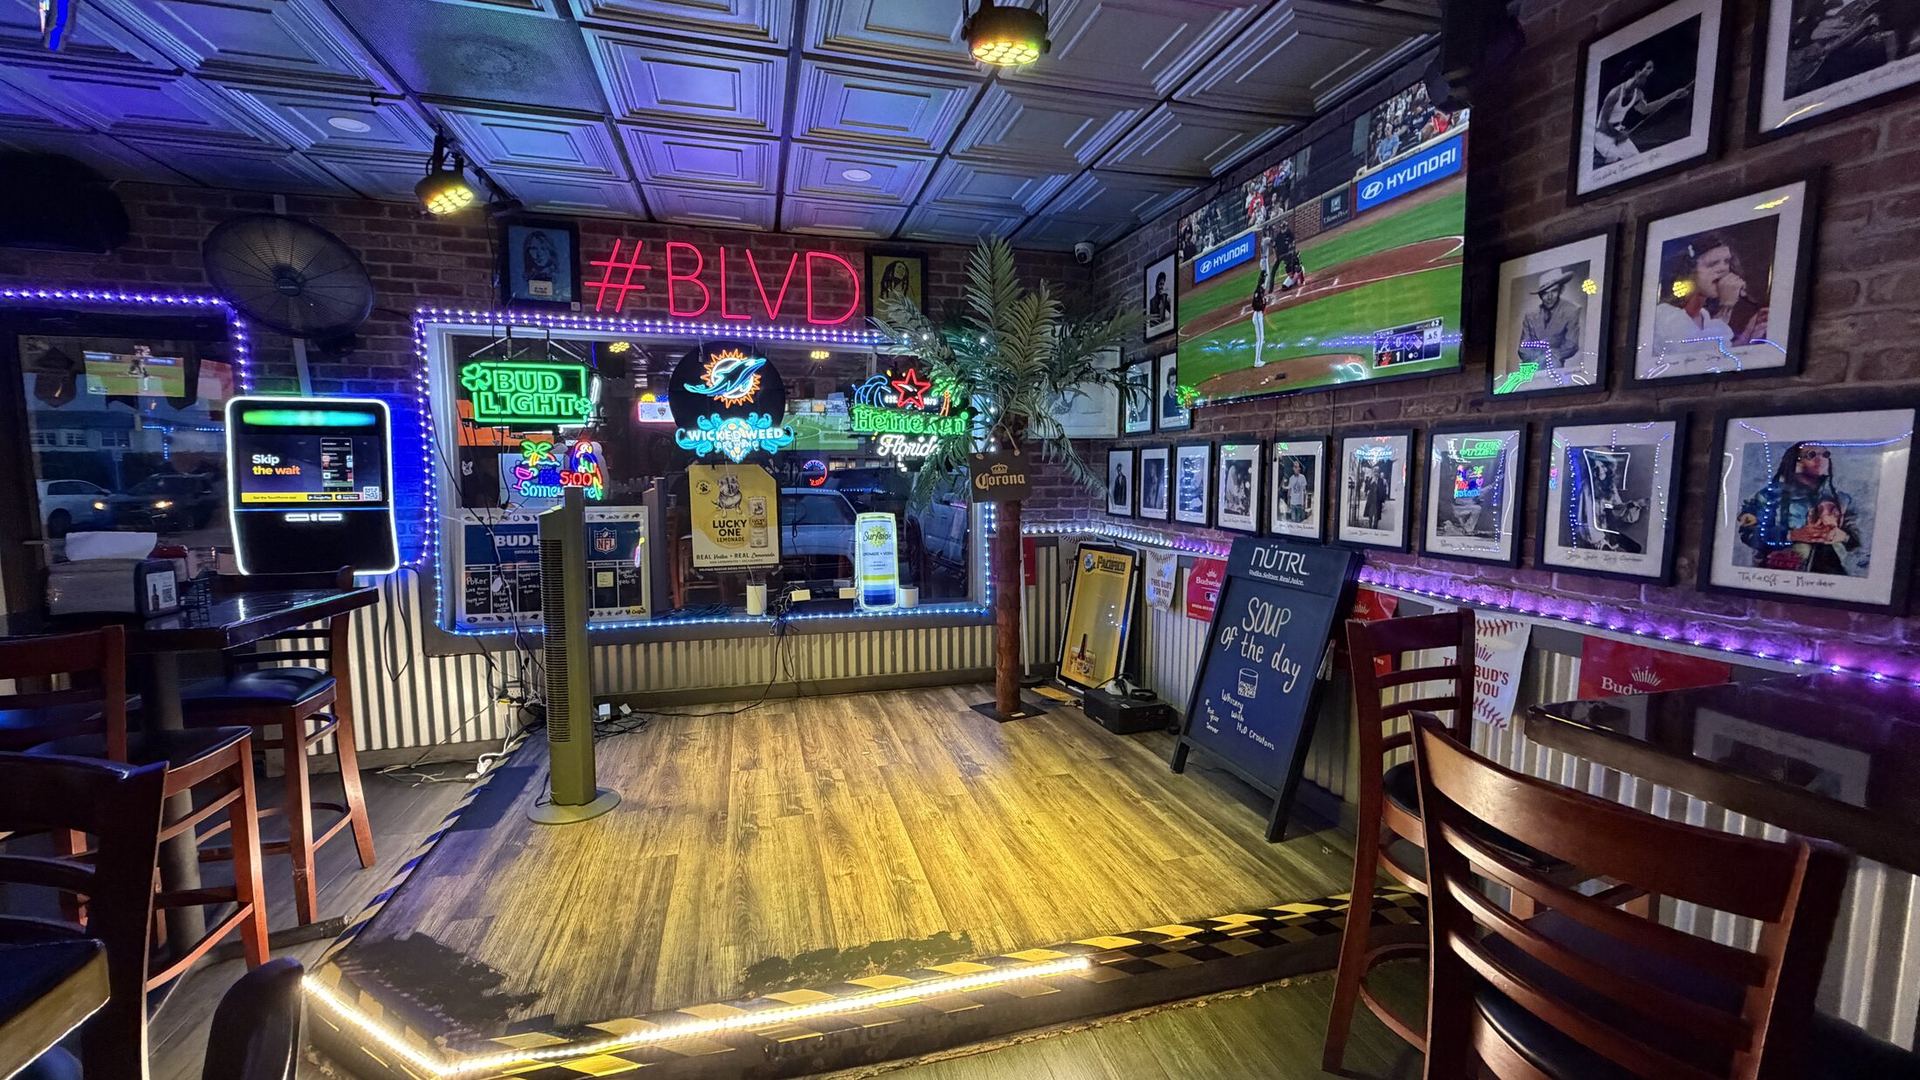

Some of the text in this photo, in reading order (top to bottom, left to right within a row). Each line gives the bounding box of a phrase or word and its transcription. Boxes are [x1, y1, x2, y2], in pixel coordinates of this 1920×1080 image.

[1386, 148, 1456, 190] HYUNDAI
[1213, 241, 1249, 268] HYUNDAI
[493, 370, 563, 393] BUD
[480, 392, 577, 416] LIGHT
[686, 427, 785, 442] WICKED WEED
[252, 454, 280, 466] Skip
[252, 465, 301, 475] the wait
[975, 473, 1026, 490] Corona
[712, 520, 747, 529] LUCKY
[718, 528, 741, 537] ONE
[495, 534, 528, 547] BUD
[597, 538, 614, 550] NFL
[1242, 596, 1292, 638] SOUP
[1220, 626, 1301, 693] of the day
[1475, 680, 1500, 699] YOU
